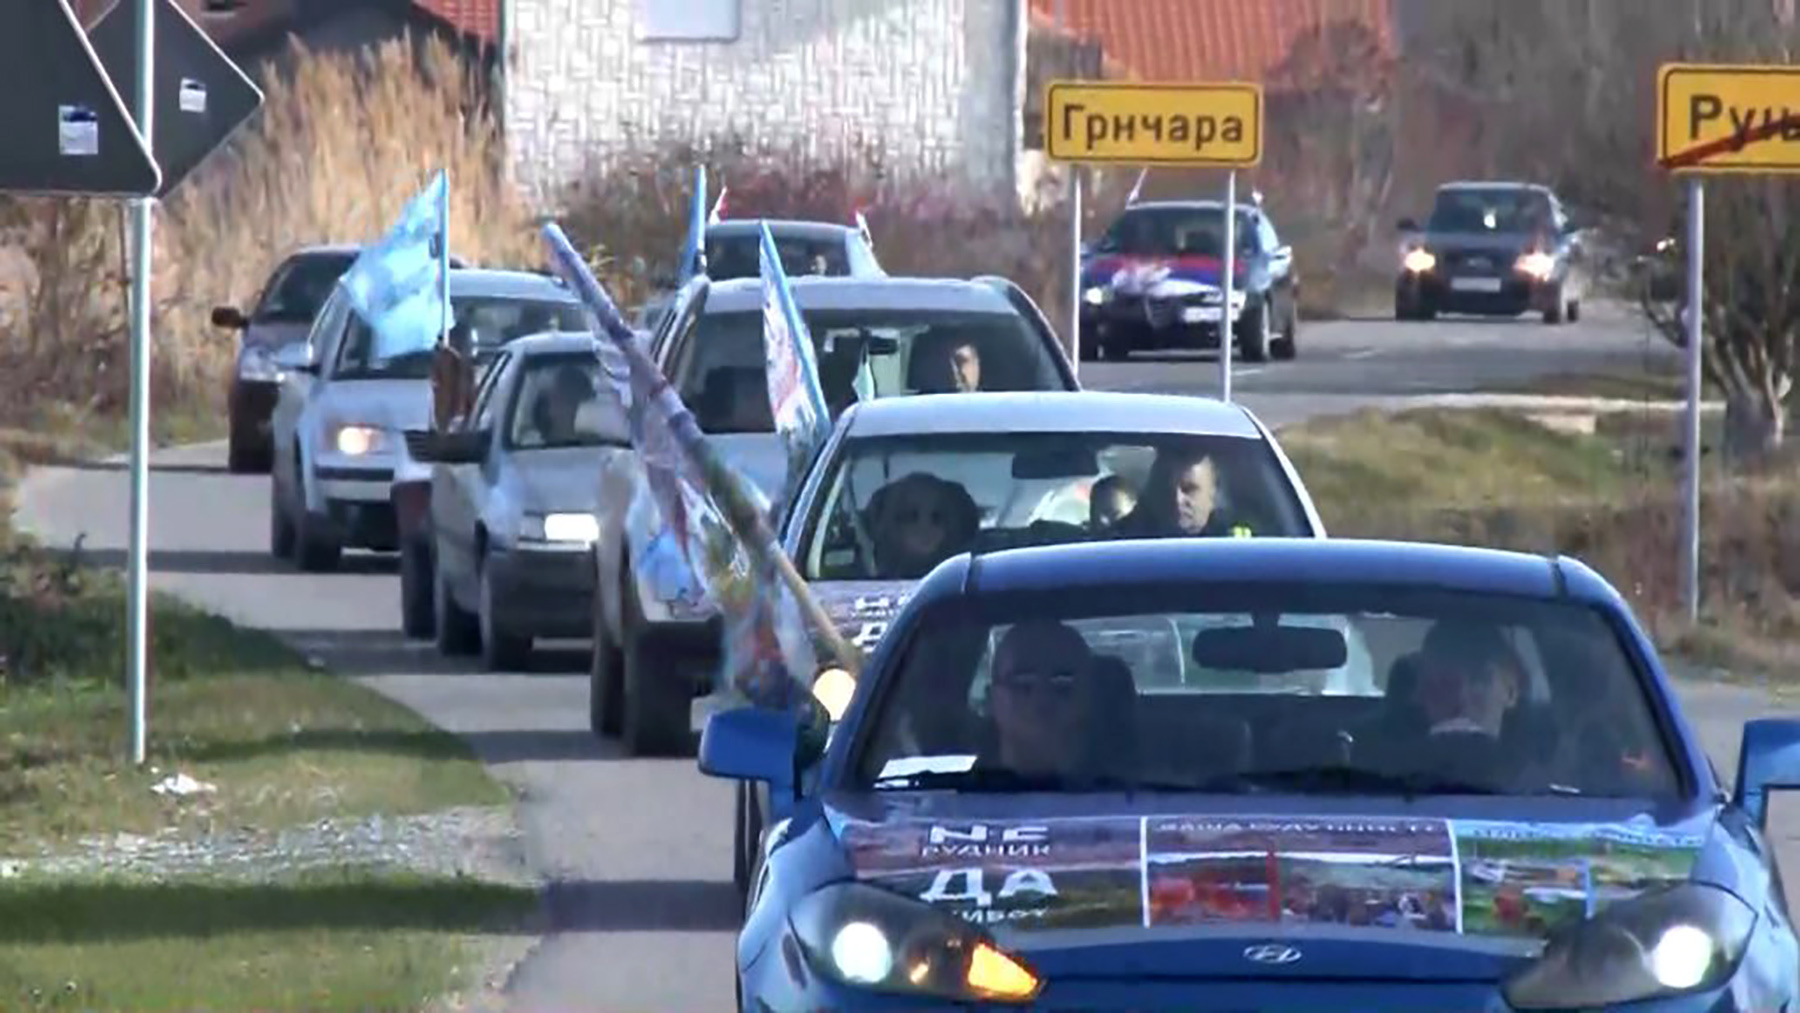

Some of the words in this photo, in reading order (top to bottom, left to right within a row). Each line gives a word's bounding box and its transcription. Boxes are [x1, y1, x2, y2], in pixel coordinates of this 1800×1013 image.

[1063, 103, 1244, 151] Грнчара
[919, 868, 1058, 906] ДА
[952, 906, 1049, 923] ИВОТ
